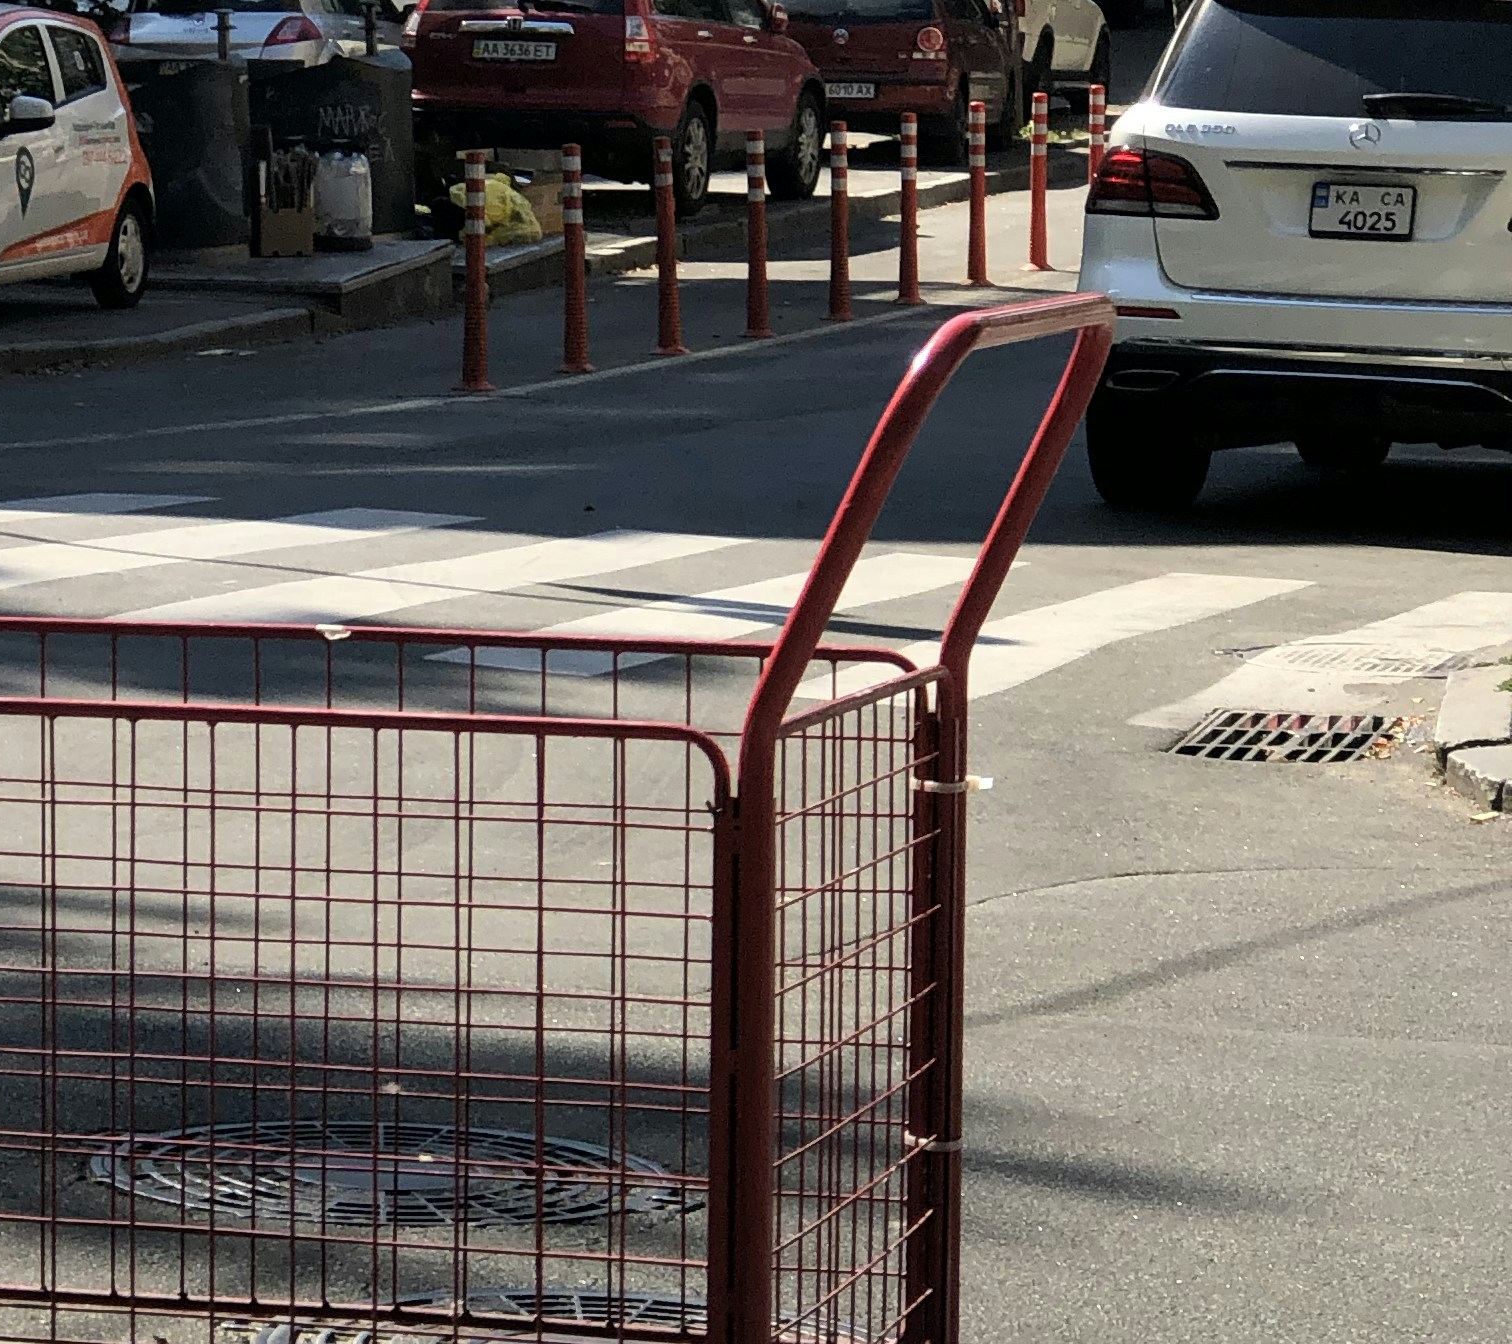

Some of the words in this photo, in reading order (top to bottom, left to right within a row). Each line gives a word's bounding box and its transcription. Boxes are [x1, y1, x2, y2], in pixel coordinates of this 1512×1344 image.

[482, 42, 500, 56] AA
[502, 43, 531, 57] 3636
[533, 44, 553, 58] ET
[856, 84, 872, 96] AX
[1334, 190, 1360, 206] KA
[1380, 191, 1405, 207] CA
[1338, 210, 1397, 232] 4025
